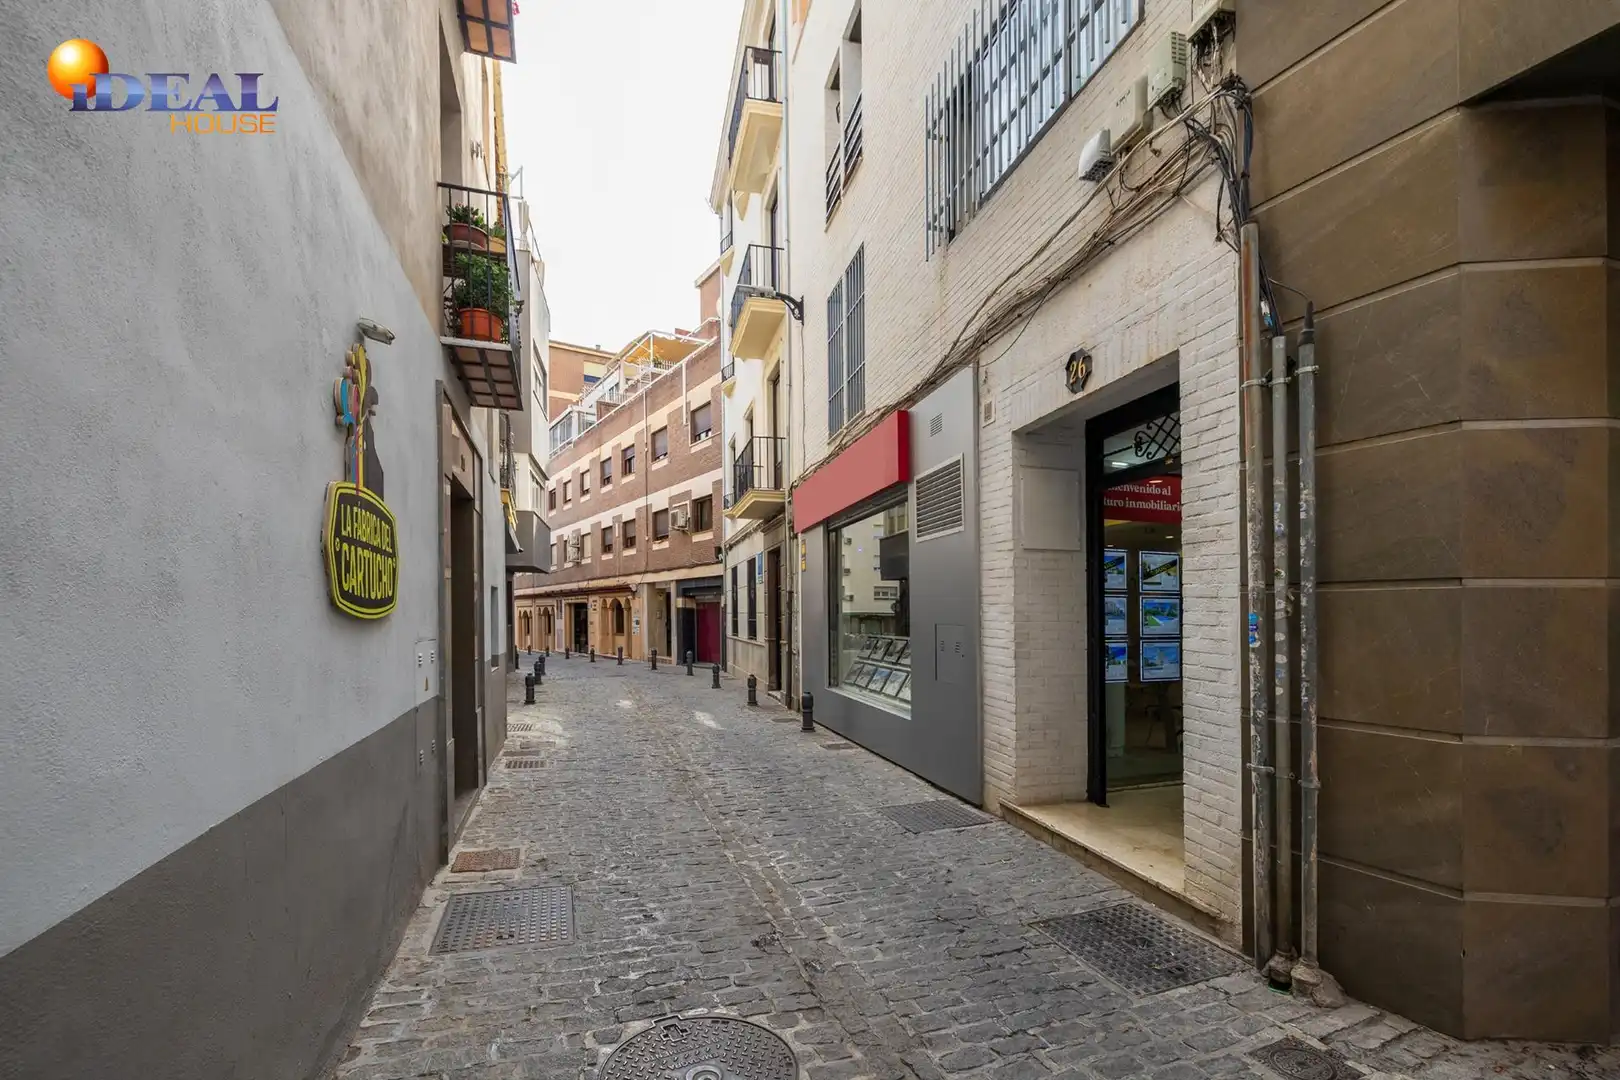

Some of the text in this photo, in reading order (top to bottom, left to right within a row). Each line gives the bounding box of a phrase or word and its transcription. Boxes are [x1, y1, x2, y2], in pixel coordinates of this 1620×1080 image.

[1069, 356, 1086, 385] 26
[1125, 497, 1182, 512] inmobiliari
[1161, 485, 1172, 496] al
[341, 503, 352, 538] LA
[381, 520, 393, 554] DEL
[341, 542, 393, 600] CARTUCHO
